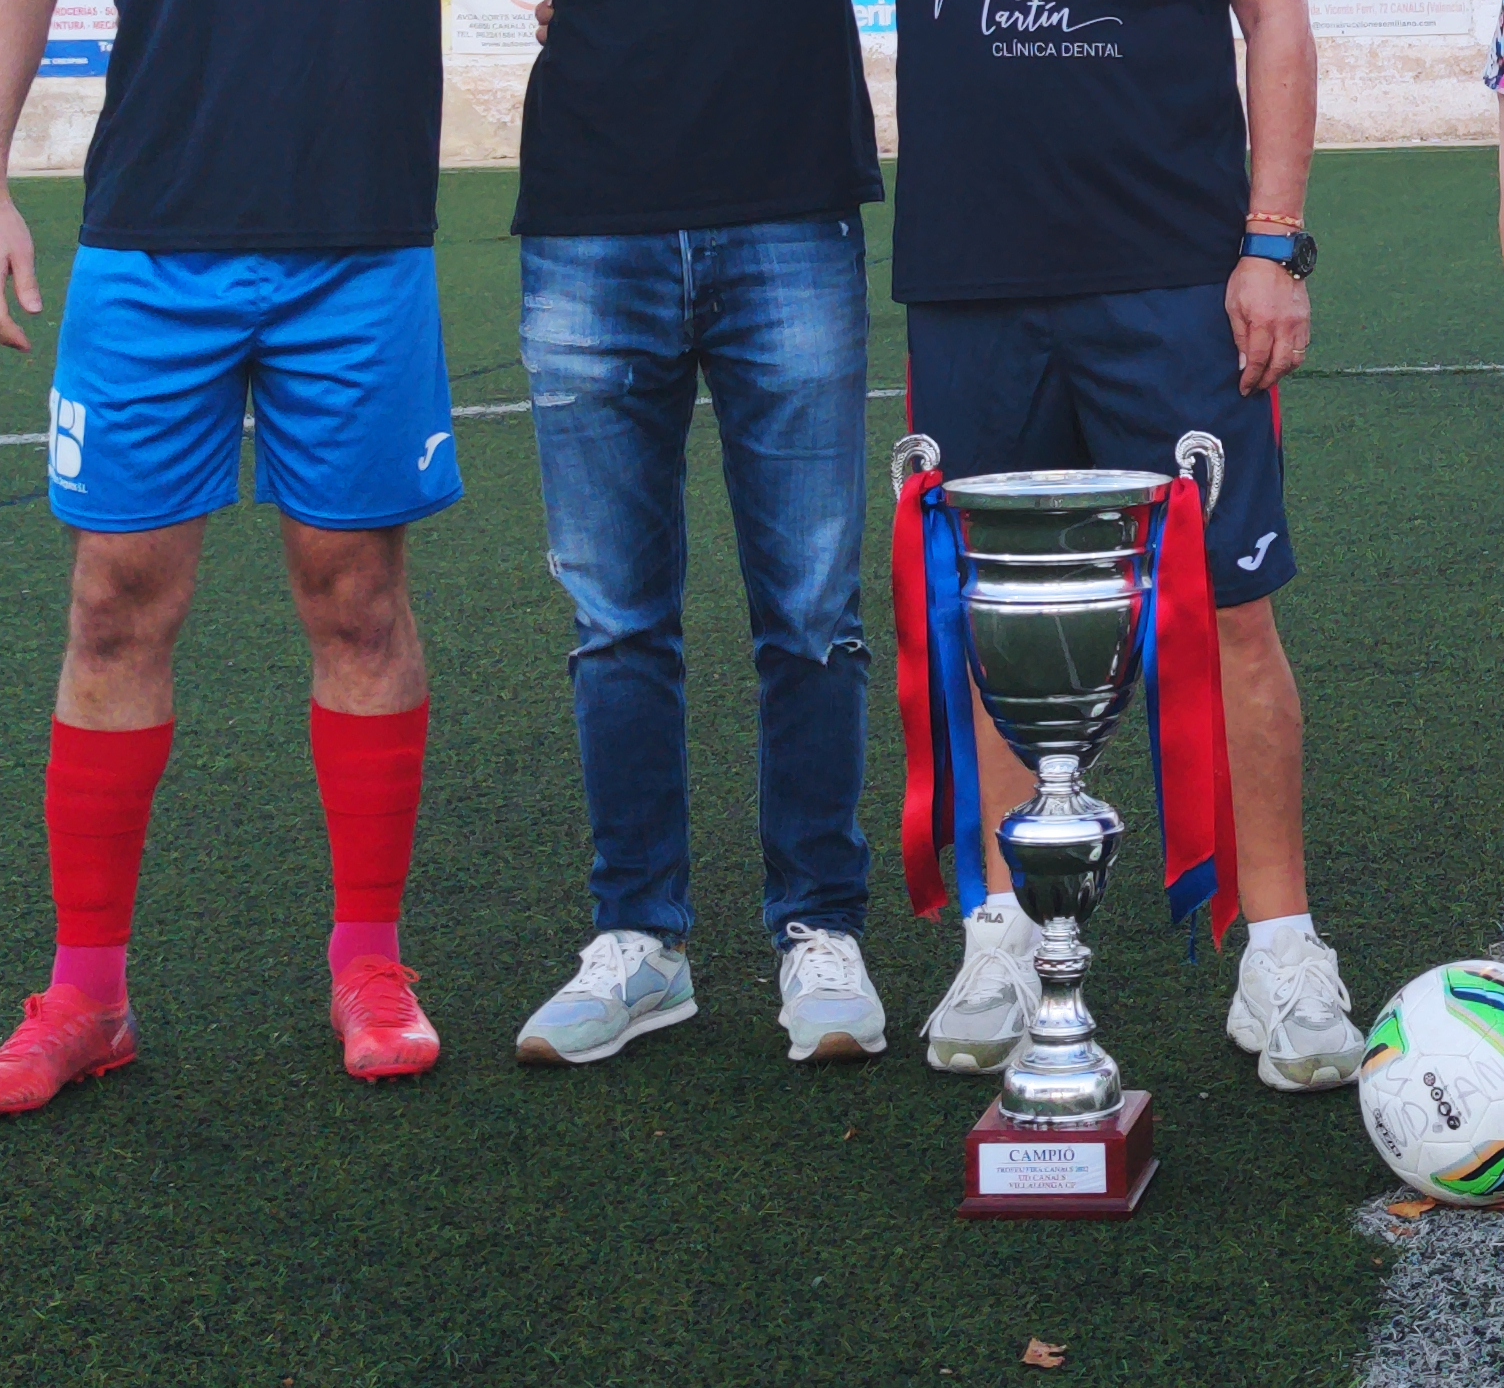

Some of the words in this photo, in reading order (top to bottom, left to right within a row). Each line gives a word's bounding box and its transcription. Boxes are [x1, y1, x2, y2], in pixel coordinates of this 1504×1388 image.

[1390, 2, 1425, 14] CANALS
[992, 39, 1057, 57] CLÍNICA
[1061, 43, 1124, 58] DENTAL
[976, 911, 1004, 924] FILA
